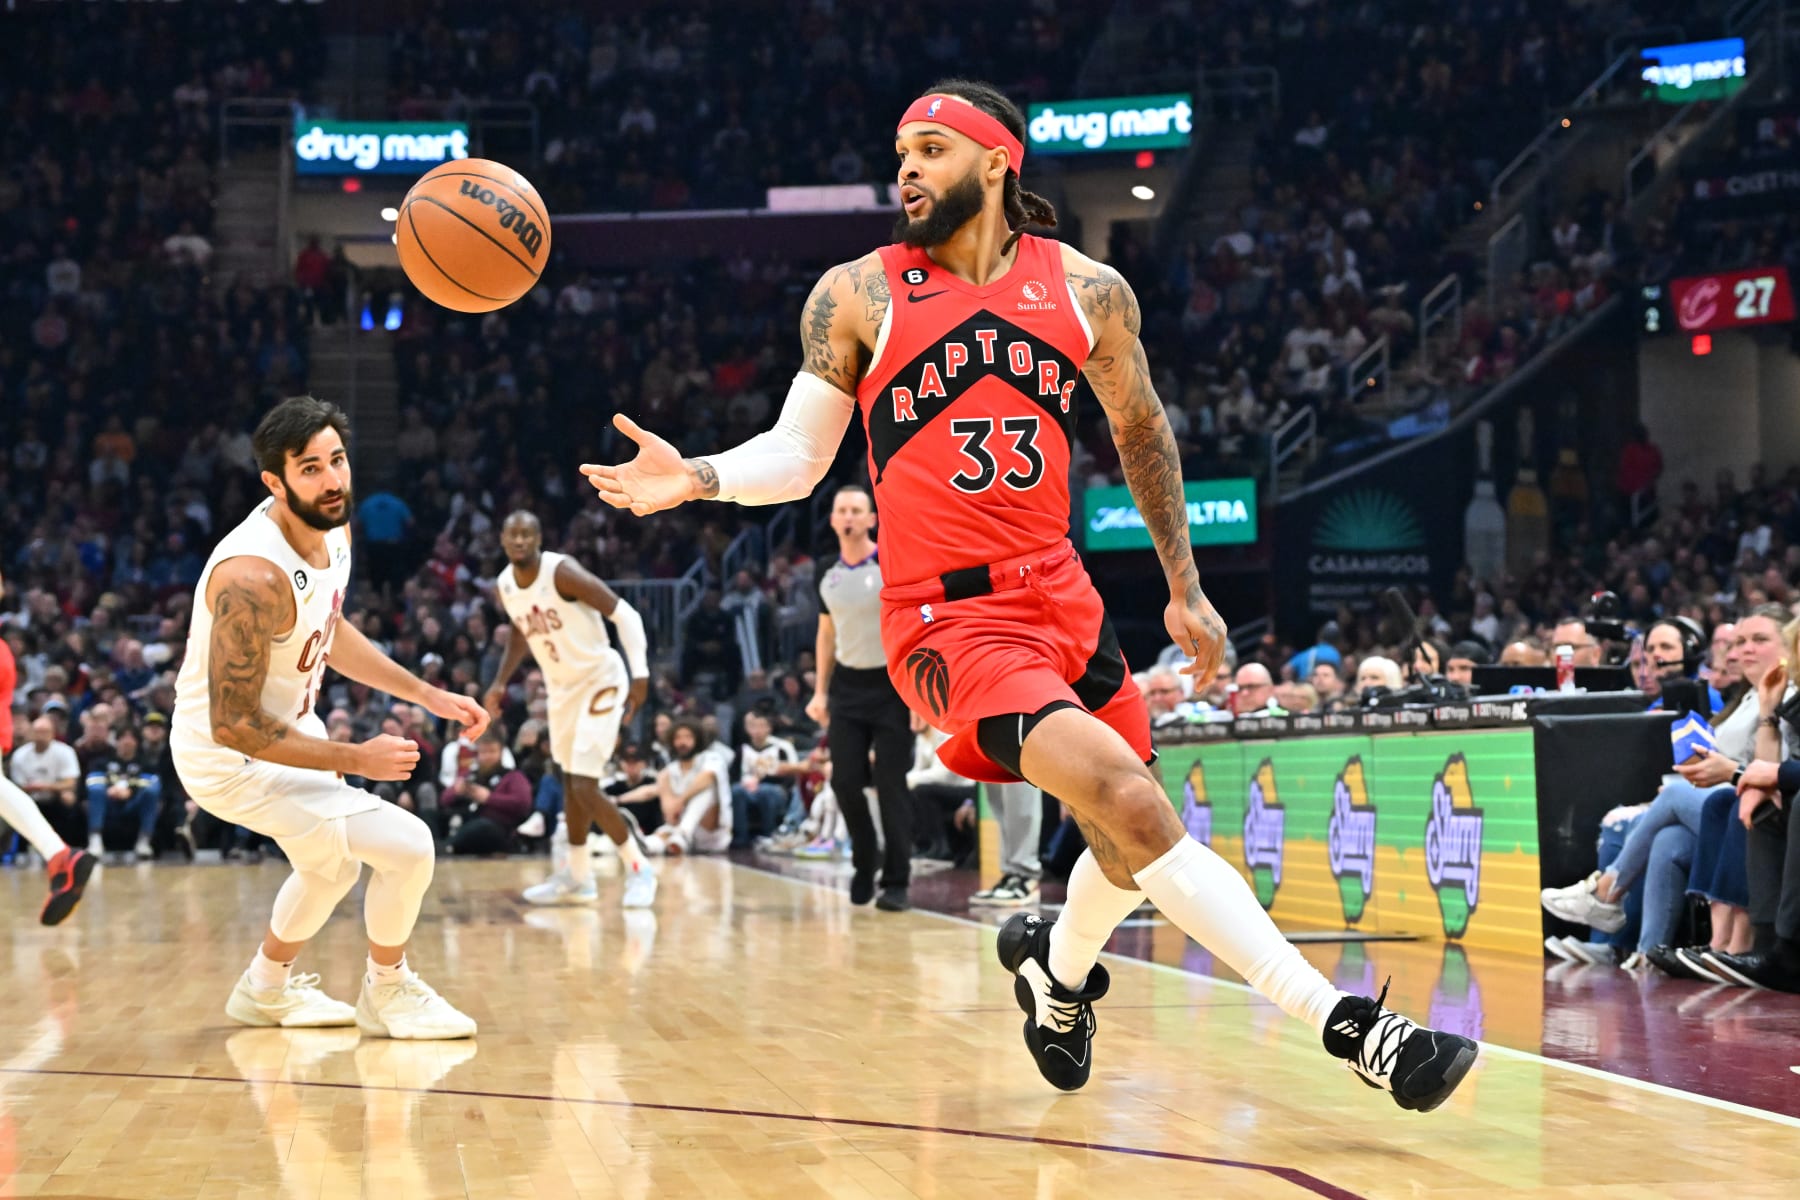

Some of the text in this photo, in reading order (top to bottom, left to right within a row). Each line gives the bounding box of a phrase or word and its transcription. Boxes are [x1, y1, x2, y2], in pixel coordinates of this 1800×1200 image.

[1029, 101, 1192, 148] drug mart
[296, 126, 469, 170] drug mart
[460, 179, 543, 259] Wilson
[906, 269, 924, 284] 6
[1734, 276, 1776, 319] 27
[1017, 302, 1057, 310] Sun Life
[892, 329, 1075, 422] RAPTORS
[949, 416, 1045, 493] 33
